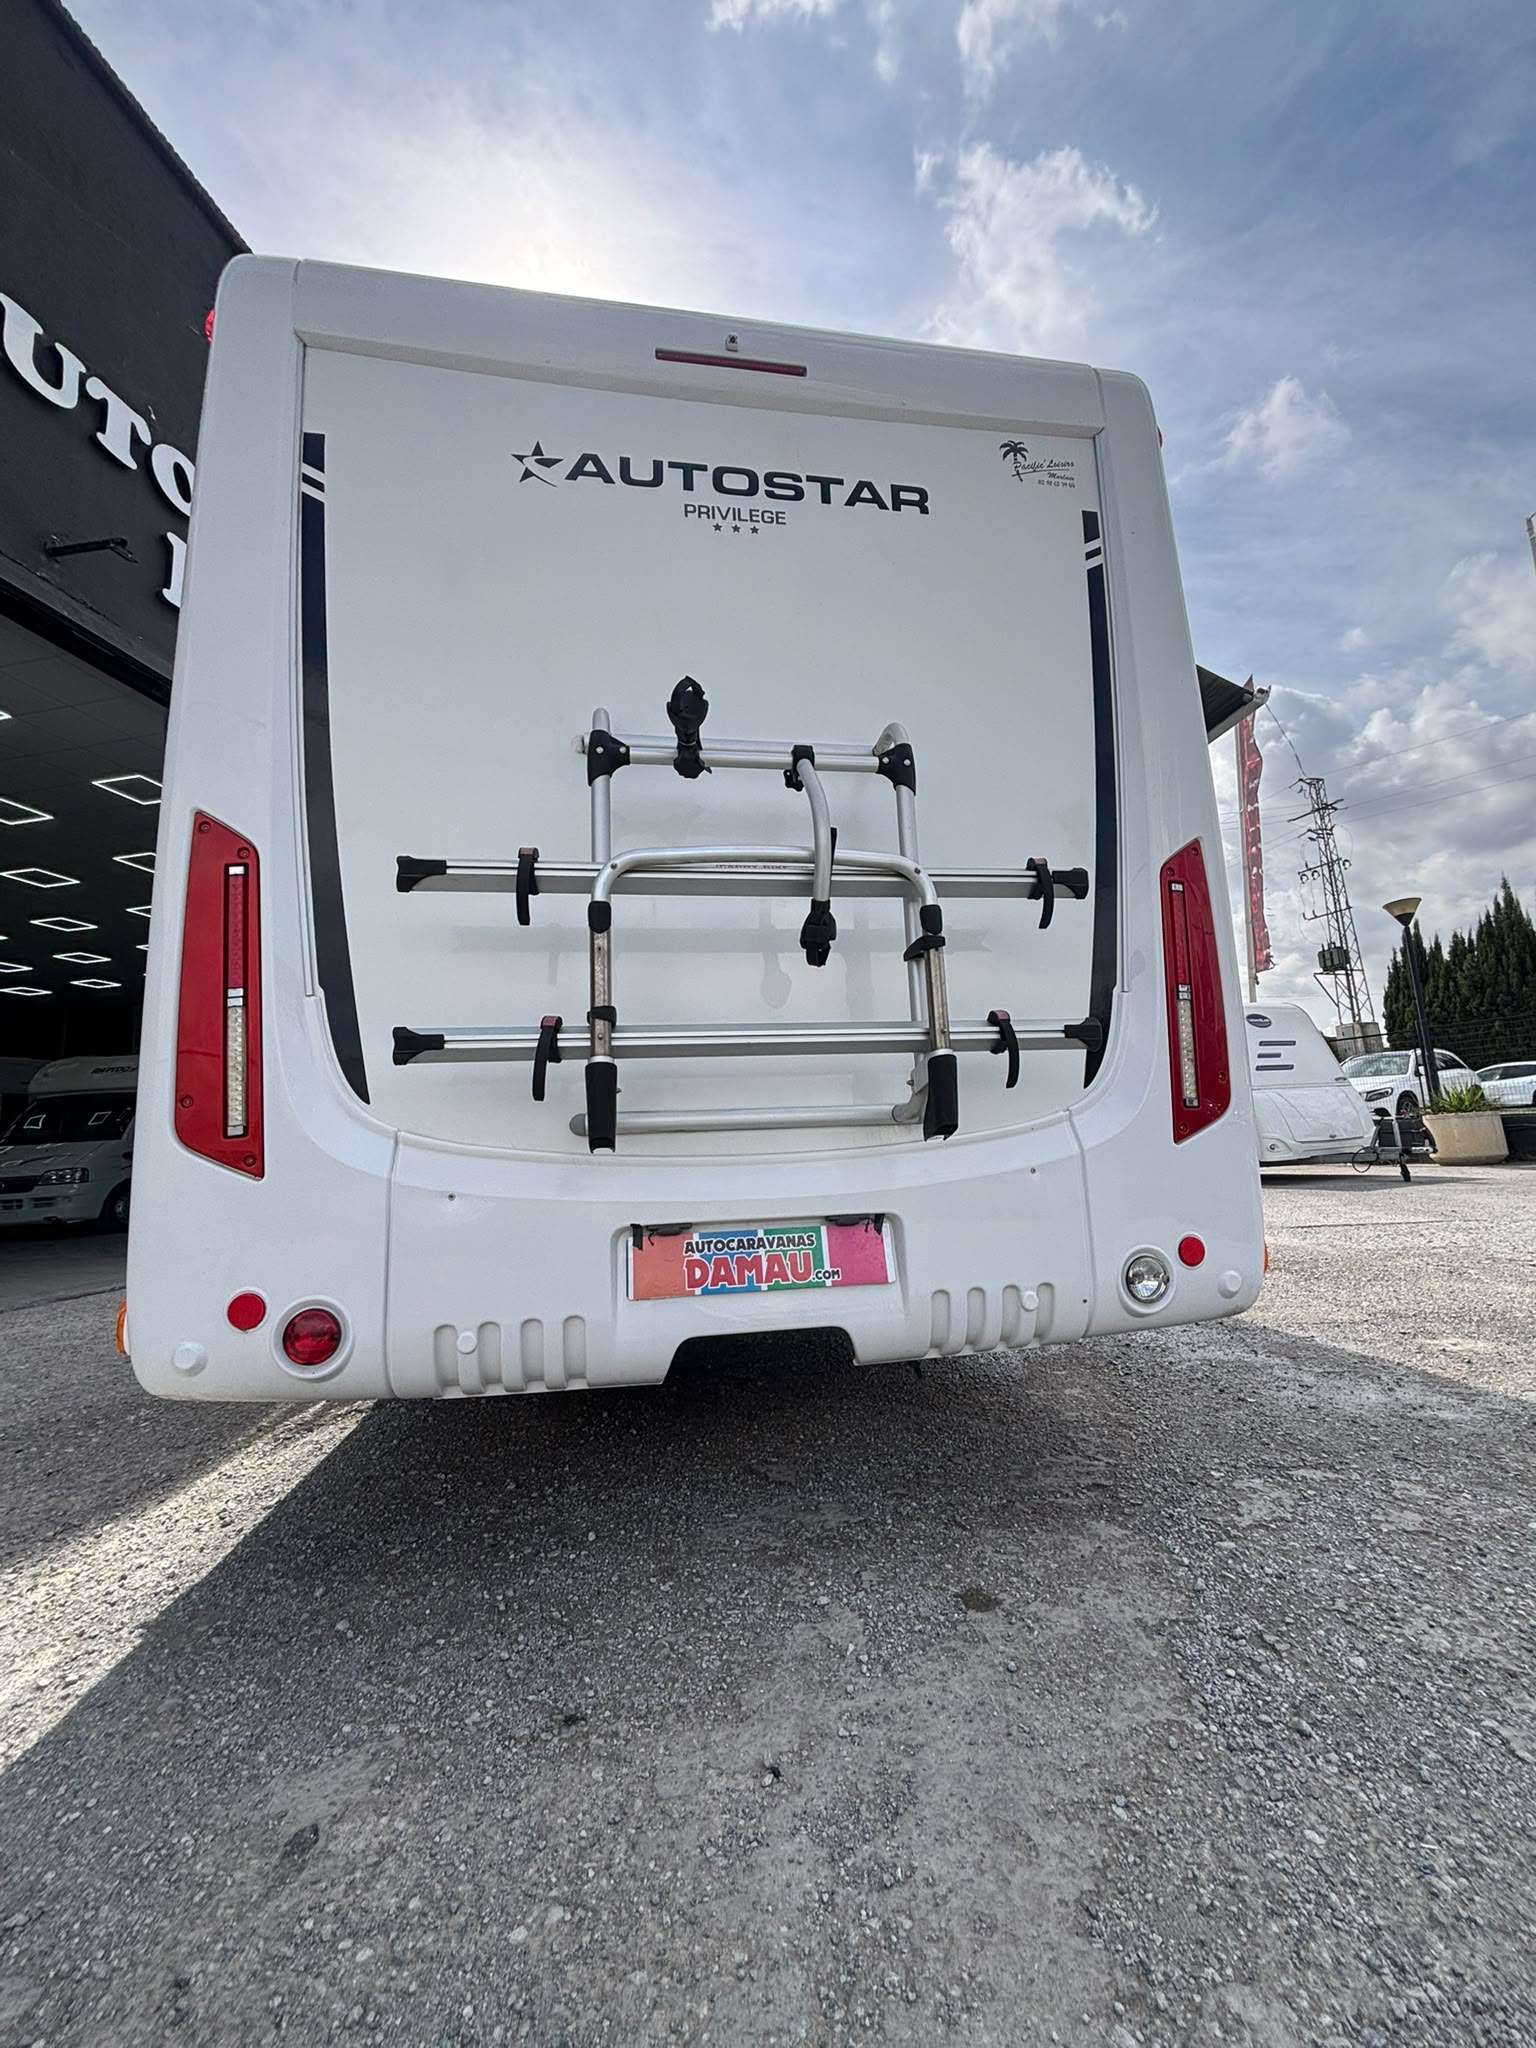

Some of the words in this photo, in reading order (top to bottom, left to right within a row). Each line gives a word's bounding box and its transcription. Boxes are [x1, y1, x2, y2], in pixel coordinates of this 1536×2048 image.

[564, 452, 931, 515] AUTOSTAR
[683, 503, 788, 526] PRIVILEGE
[684, 1234, 815, 1255] AUTOCARAVANAS
